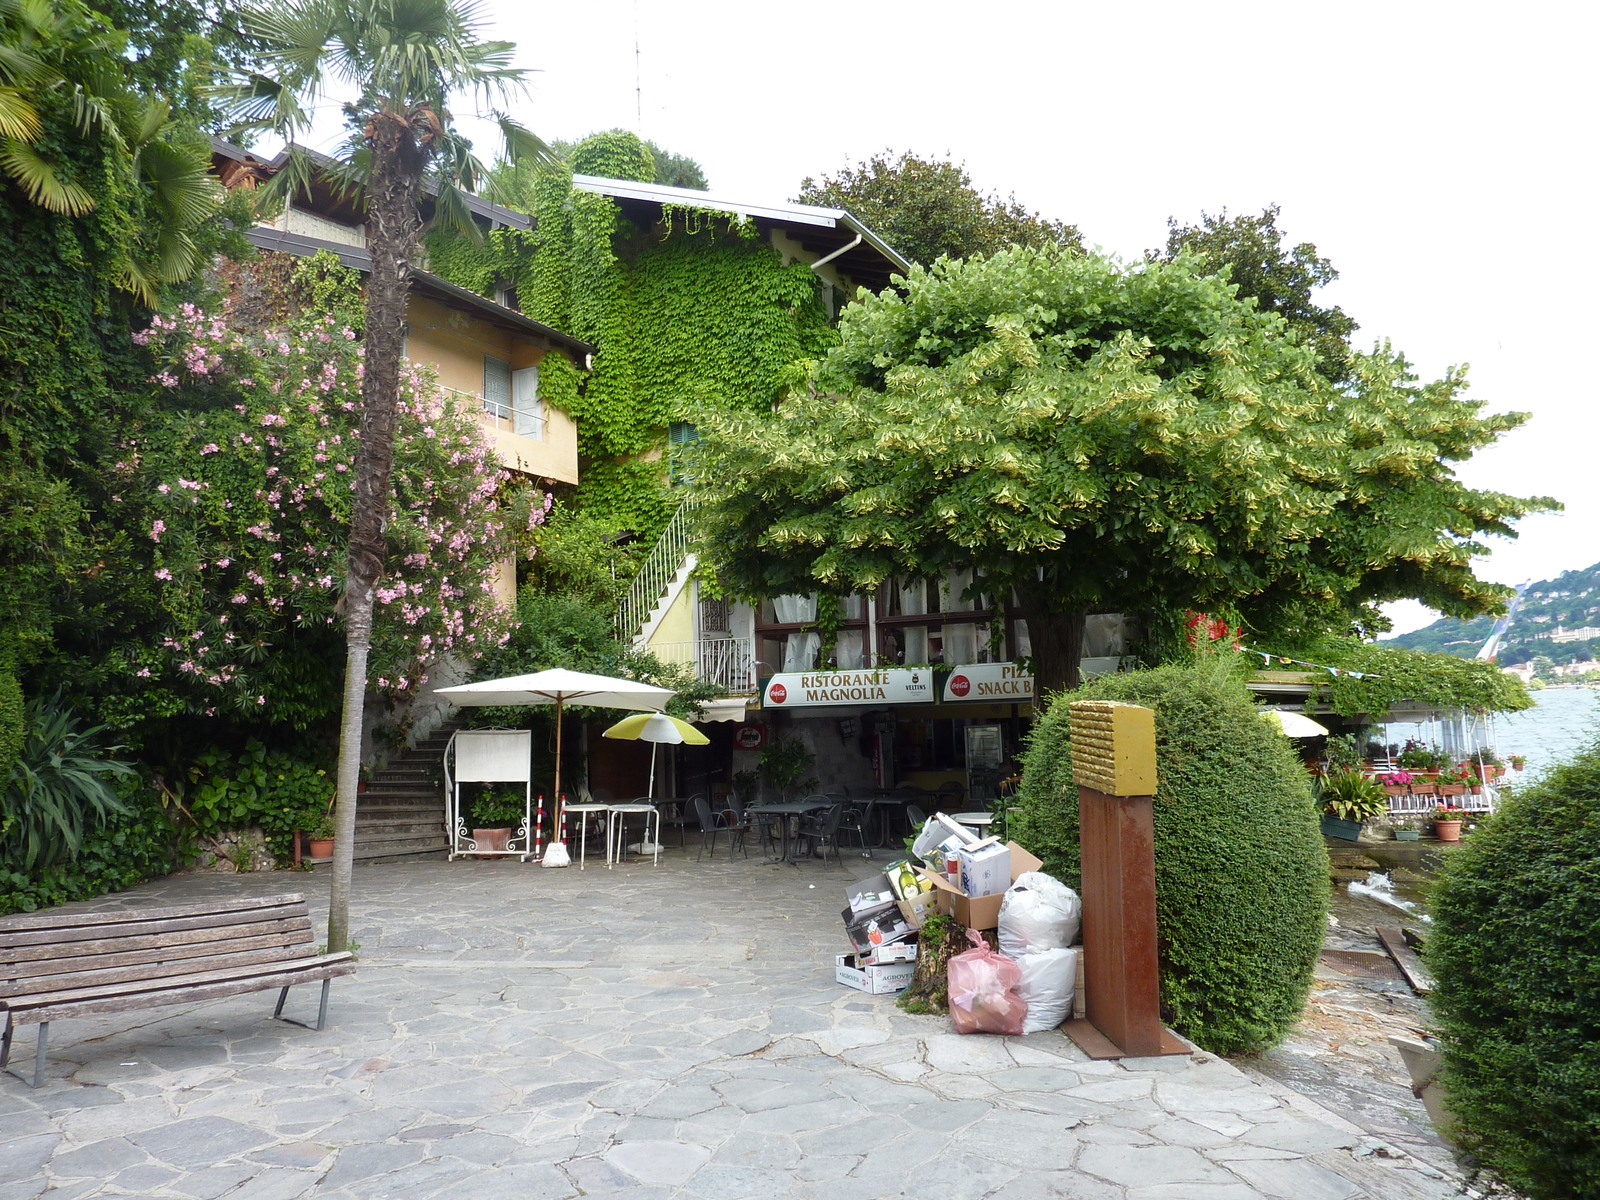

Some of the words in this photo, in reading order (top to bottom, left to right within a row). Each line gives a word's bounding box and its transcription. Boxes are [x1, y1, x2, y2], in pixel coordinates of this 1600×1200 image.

[1002, 666, 1034, 679] PIZ
[801, 673, 890, 688] RISTORANTE
[977, 680, 1020, 695] SNACK
[1023, 680, 1035, 693] B
[806, 687, 886, 702] MAGNOLIA
